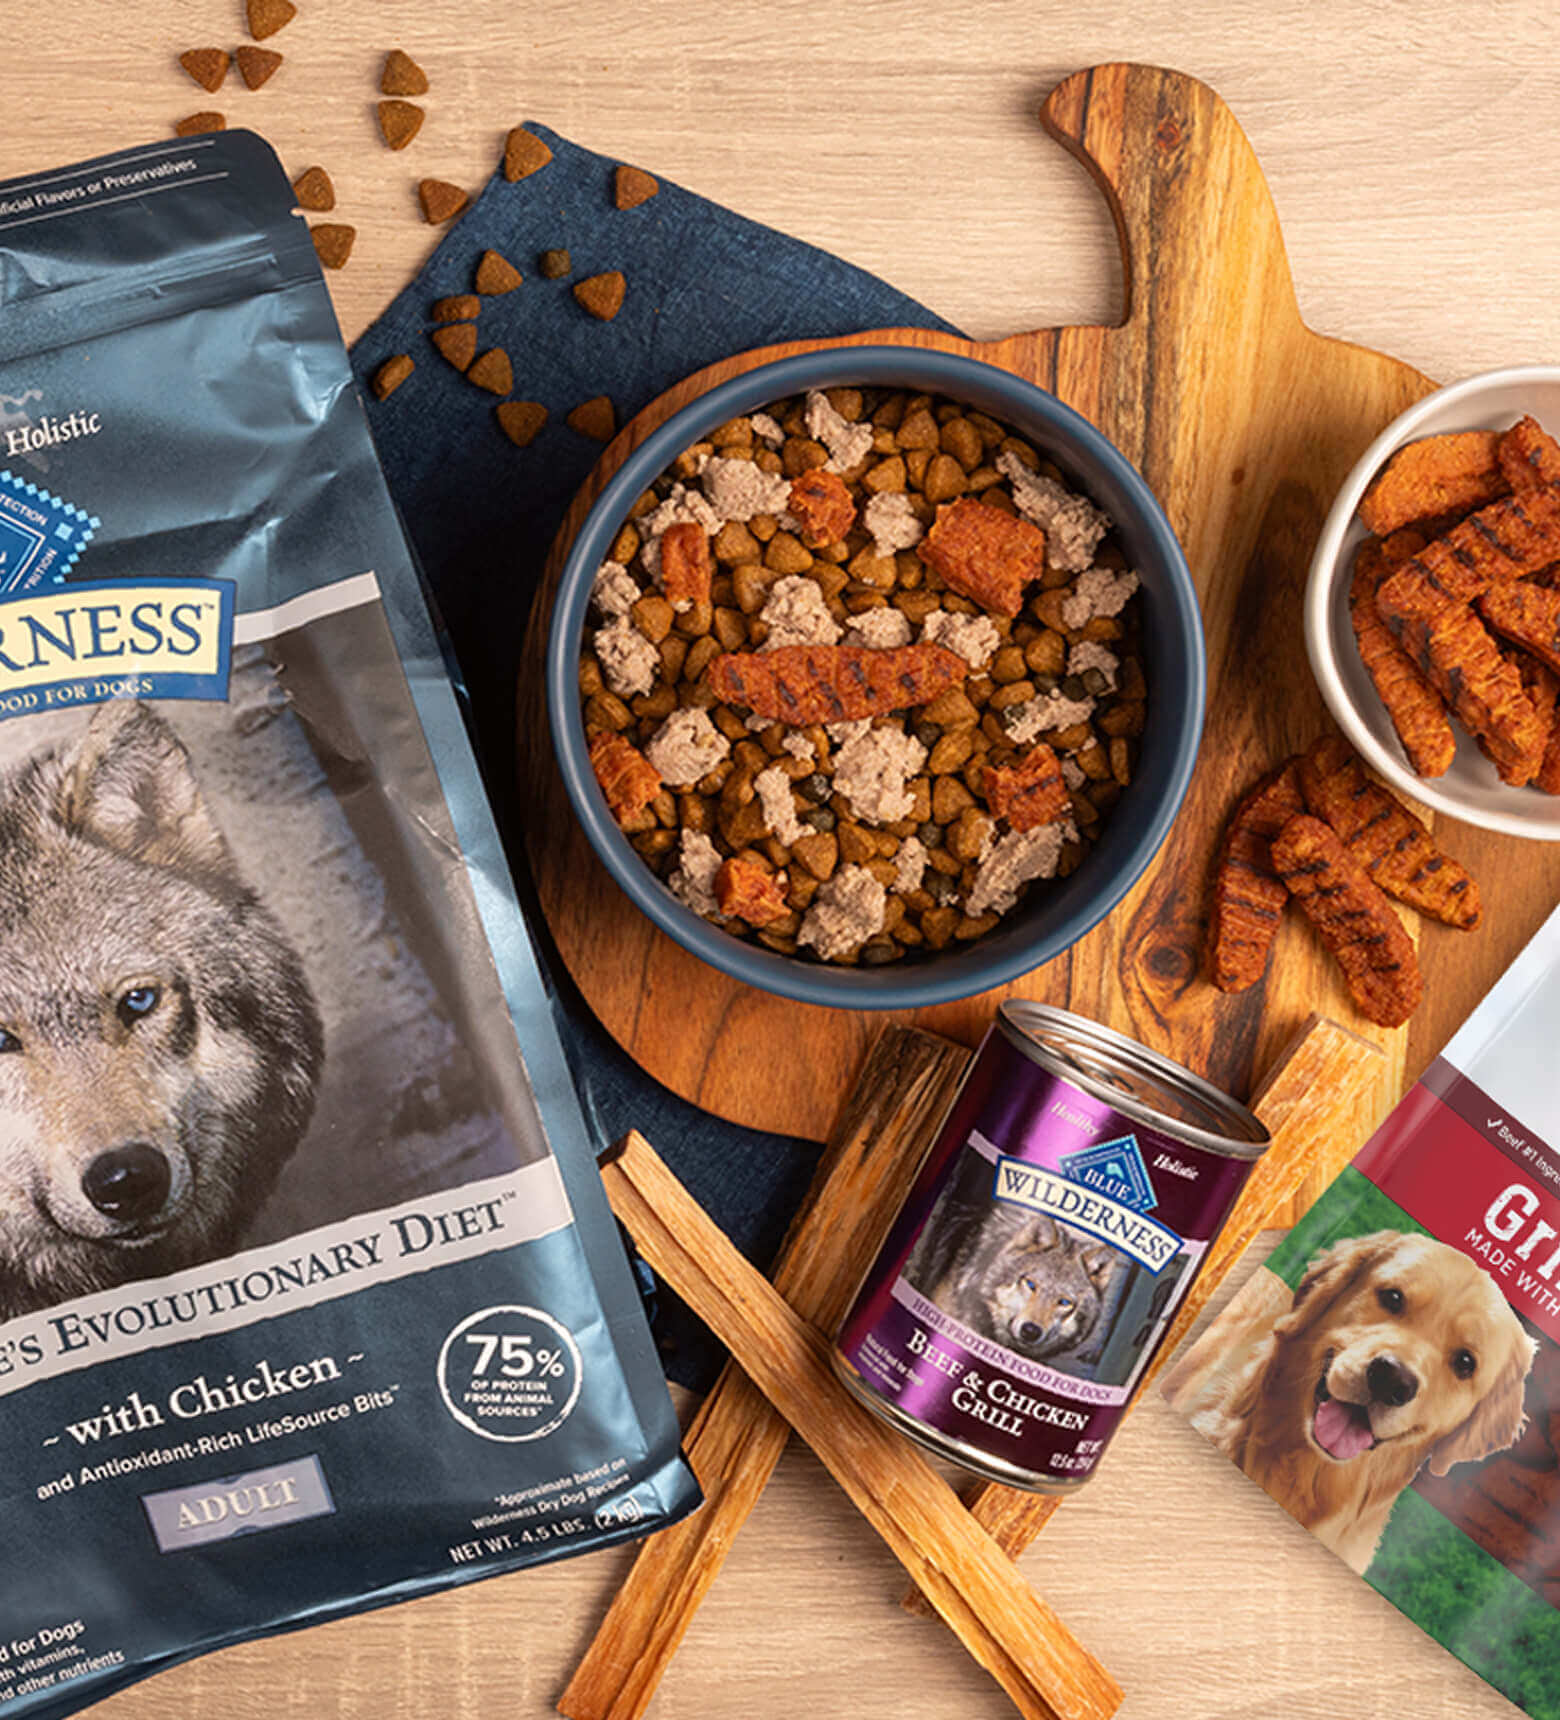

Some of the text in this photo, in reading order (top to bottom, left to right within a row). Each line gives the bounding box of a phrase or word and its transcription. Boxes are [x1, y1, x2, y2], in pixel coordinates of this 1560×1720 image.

[35, 185, 86, 210] Flavors
[85, 181, 102, 199] or
[103, 157, 198, 193] Preservatives
[5, 410, 103, 457] Holistic
[46, 680, 89, 705] FOR
[93, 676, 155, 699] DOGS
[1051, 1101, 1100, 1137] Healthy
[1497, 1125, 1524, 1151] Beef
[1521, 1143, 1539, 1162] #1
[1083, 1168, 1132, 1201] BLUE
[1153, 1153, 1200, 1181] Holistic
[1003, 1167, 1173, 1262] WILDERNESS
[1464, 1227, 1517, 1277] MADE
[55, 1241, 382, 1356] EVOLUTIONARY
[466, 1334, 565, 1377] 75%
[912, 1298, 1008, 1367] HIGH-PROTEIN
[1008, 1355, 1052, 1384] FOOD
[1053, 1374, 1080, 1396] FOR
[1080, 1385, 1113, 1401] DOGS
[66, 1354, 342, 1446] with Chicken
[464, 1393, 554, 1405] FROM ANIMAL
[471, 1381, 547, 1391] OF PROTEIN
[906, 1327, 964, 1378] BEEF
[962, 1370, 984, 1392] &
[986, 1379, 1090, 1431] CHICKEN
[952, 1387, 1025, 1437] GRILL
[37, 1474, 75, 1500] and
[79, 1430, 243, 1485] Antioxidant-Rich
[245, 1401, 351, 1444] LifeSource
[573, 1462, 611, 1485] based
[611, 1457, 627, 1471] on
[177, 1477, 300, 1530] ADULT
[471, 1506, 537, 1529] Wilderness
[537, 1499, 560, 1514] Dry
[560, 1491, 586, 1506] Dog
[448, 1495, 644, 1565] NET WT. 4.5 LBS. (2 kg)
[11, 1638, 36, 1657] for
[39, 1619, 86, 1648] Dogs
[17, 1642, 86, 1675] vitamins,
[17, 1674, 57, 1695] other
[58, 1650, 126, 1681] nutrients
